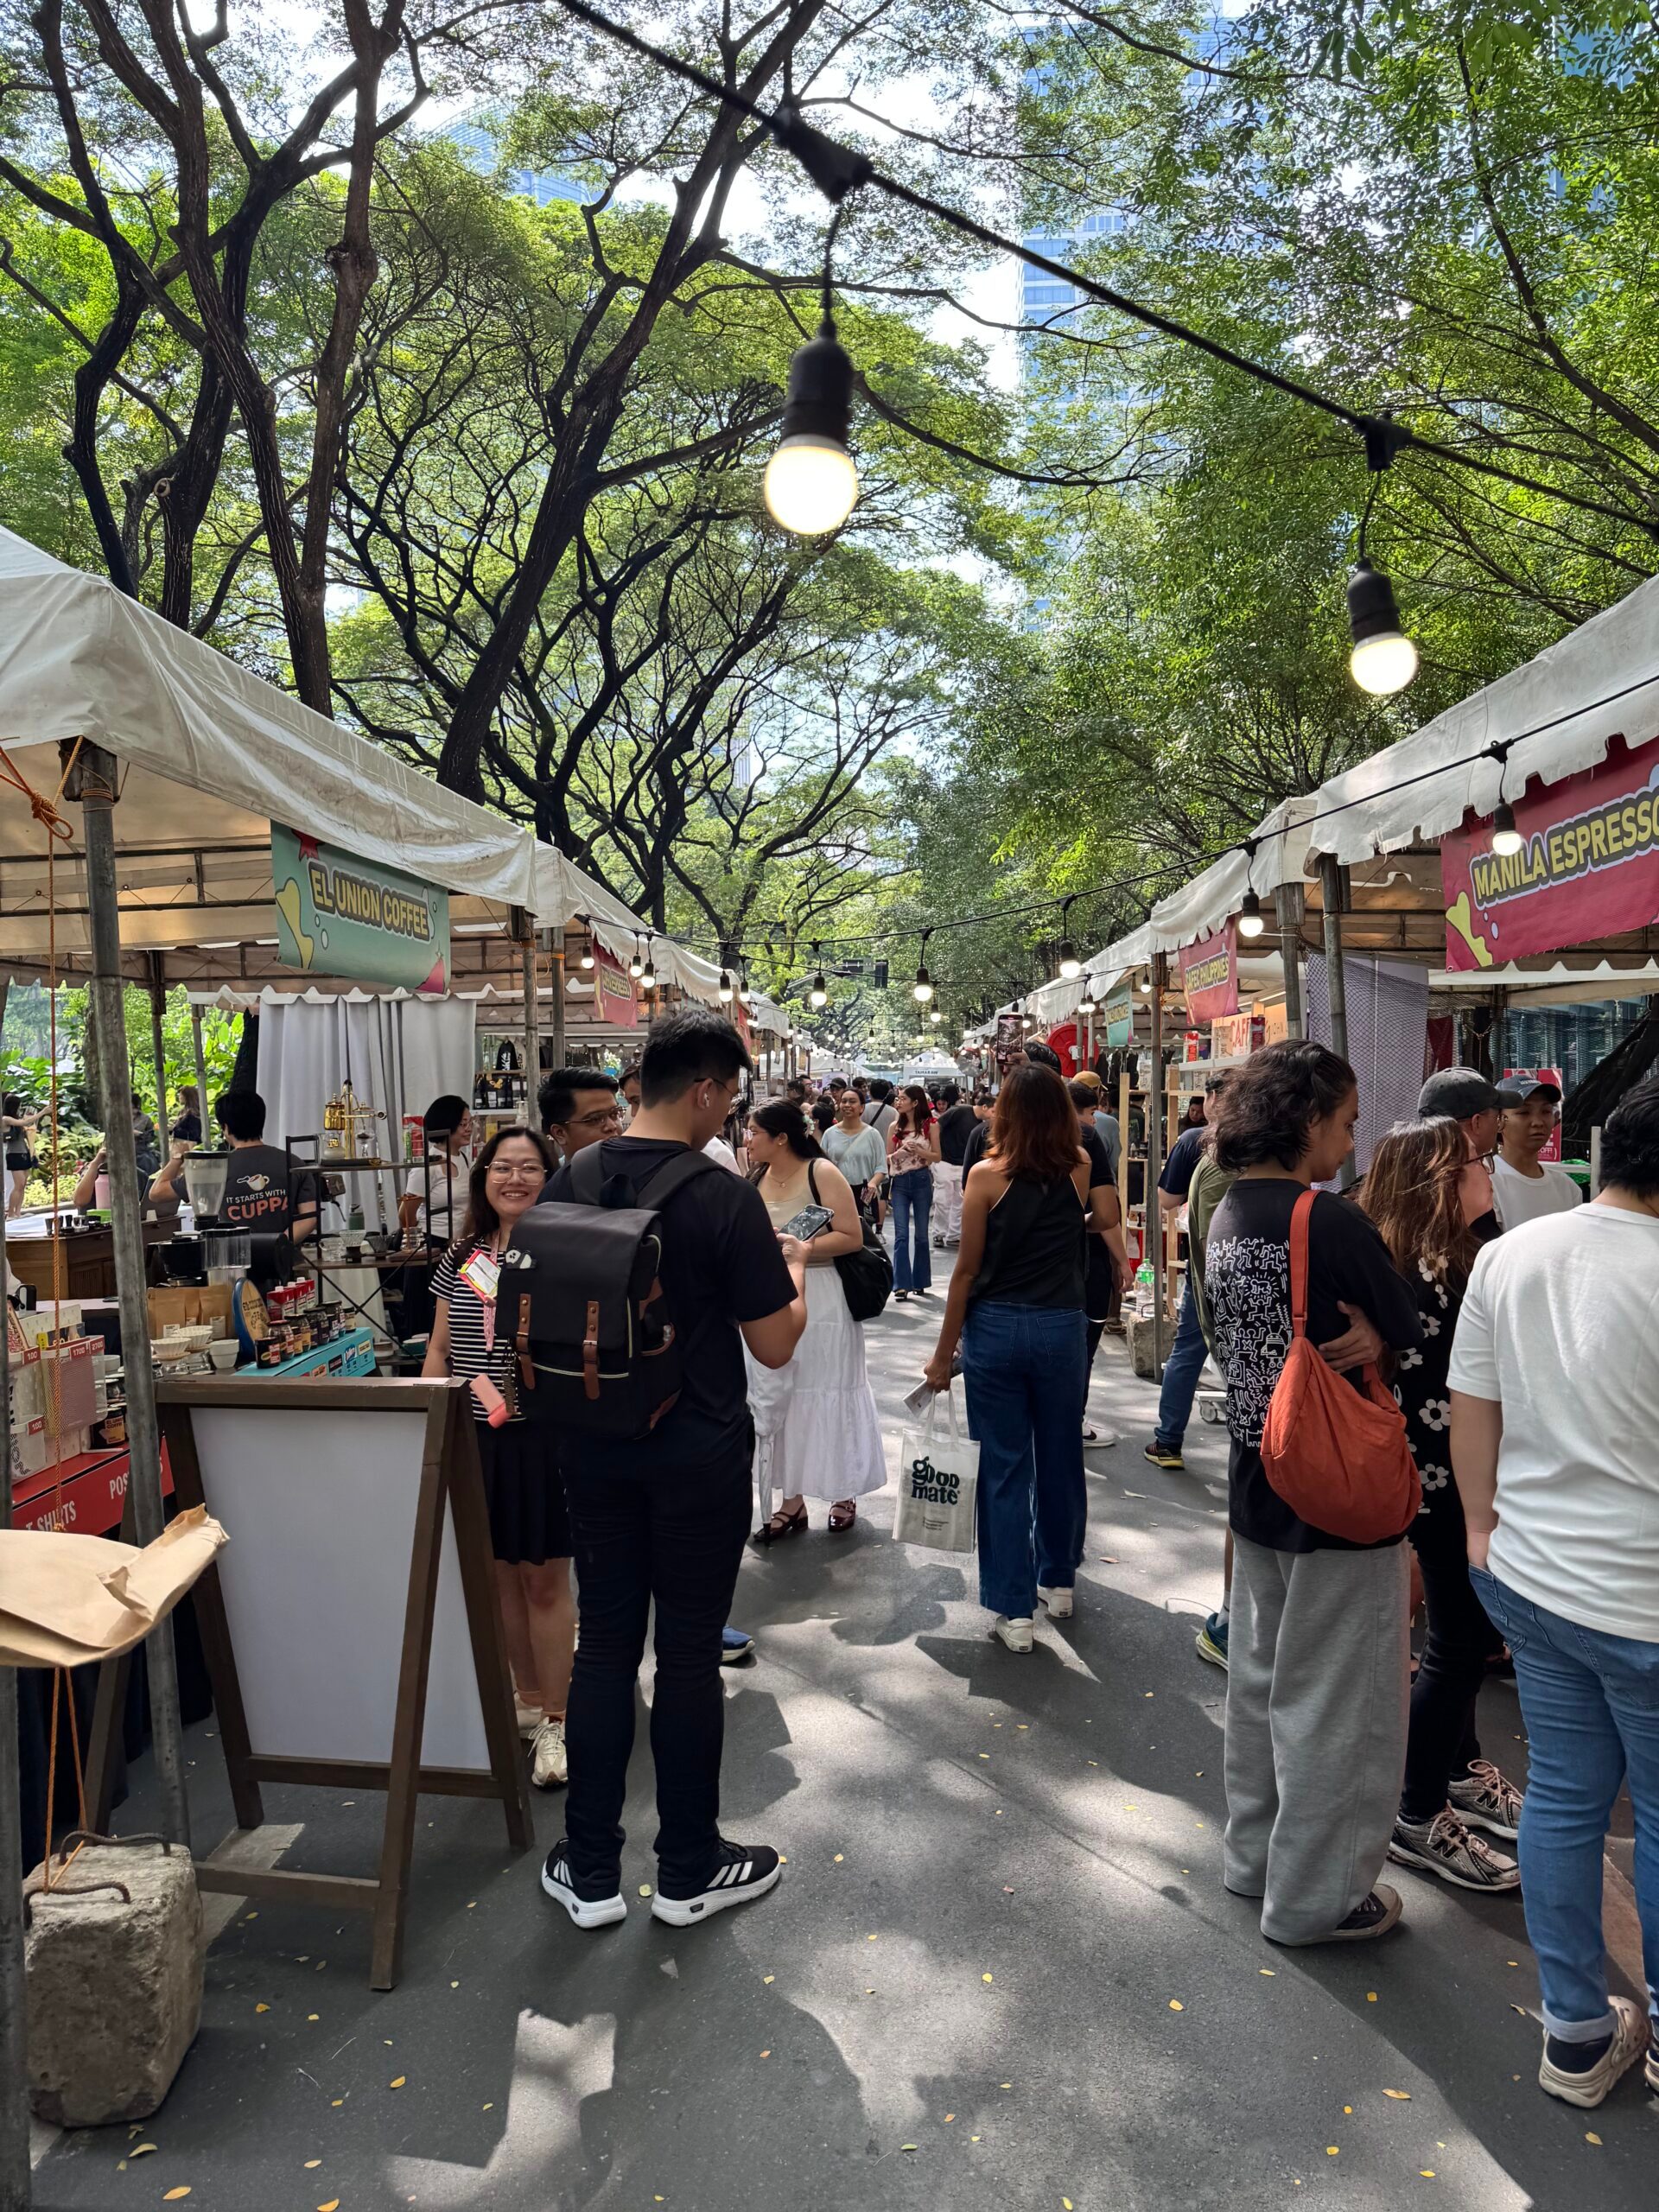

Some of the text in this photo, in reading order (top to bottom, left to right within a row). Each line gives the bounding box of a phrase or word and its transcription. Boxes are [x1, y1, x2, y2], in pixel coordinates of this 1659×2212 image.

[1474, 842, 1547, 899] MANILA
[311, 870, 429, 936] EL UNION COFFEE
[235, 1192, 264, 1204] STARTS
[265, 1189, 286, 1198] WITH
[73, 1346, 86, 1357] 1700
[92, 1340, 104, 1351] 2700
[27, 1351, 38, 1361] 100
[32, 1421, 42, 1430] 100
[911, 1484, 958, 1505] mate
